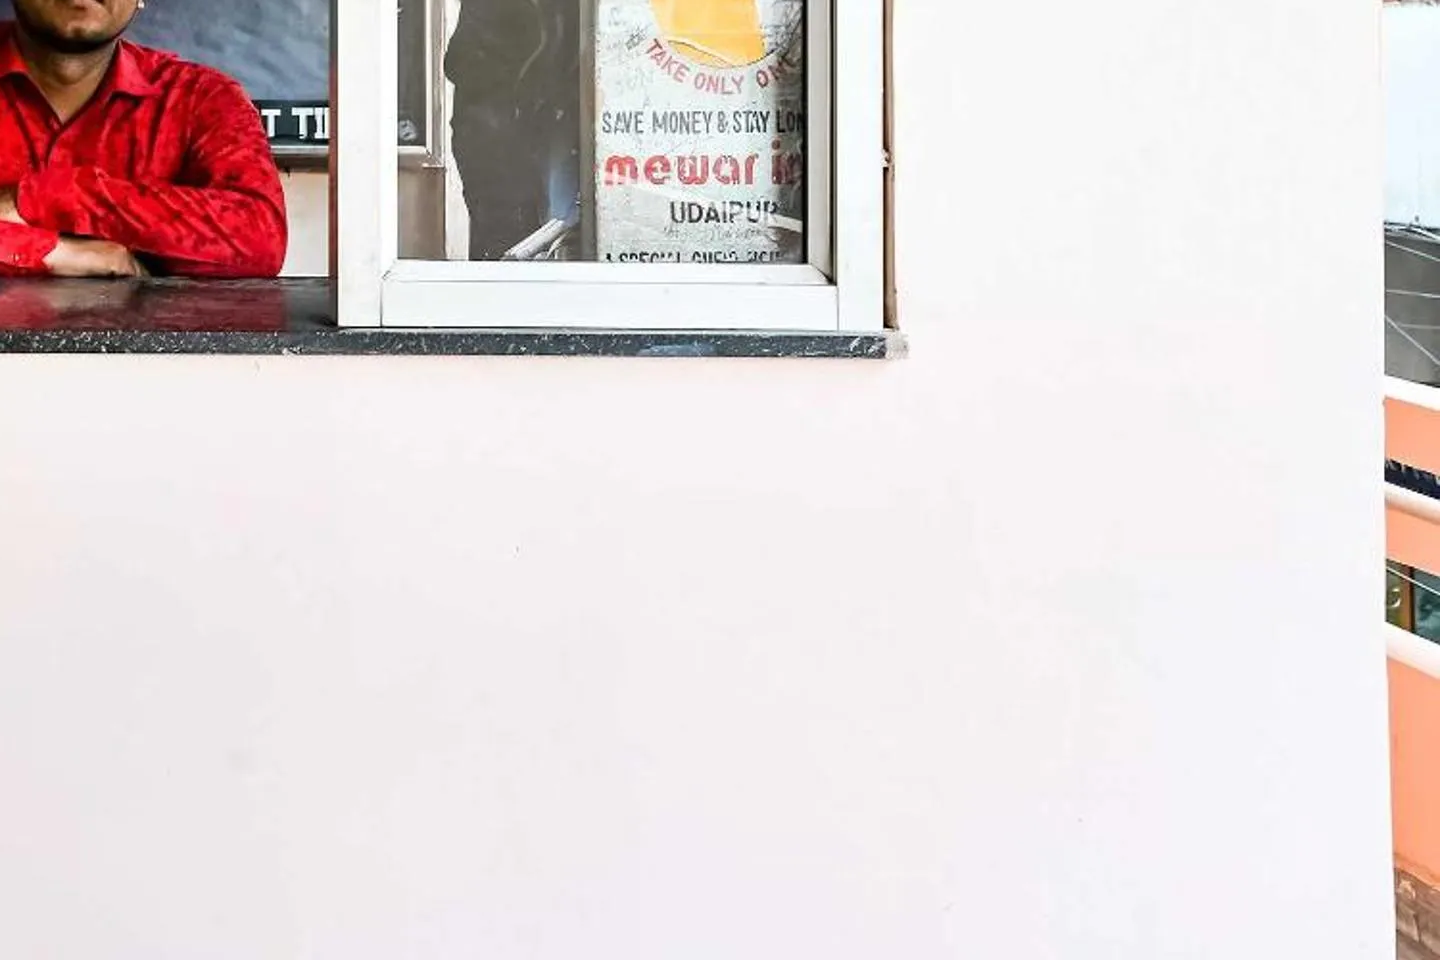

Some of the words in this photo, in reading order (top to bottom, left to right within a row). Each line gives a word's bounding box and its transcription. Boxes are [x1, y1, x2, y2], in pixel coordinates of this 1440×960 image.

[645, 38, 690, 83] TAKE
[694, 72, 744, 96] ONLY
[602, 111, 644, 134] SAVE
[651, 111, 713, 134] MONEY
[717, 111, 729, 134] &
[733, 110, 770, 133] STAY
[604, 154, 759, 185] mewar
